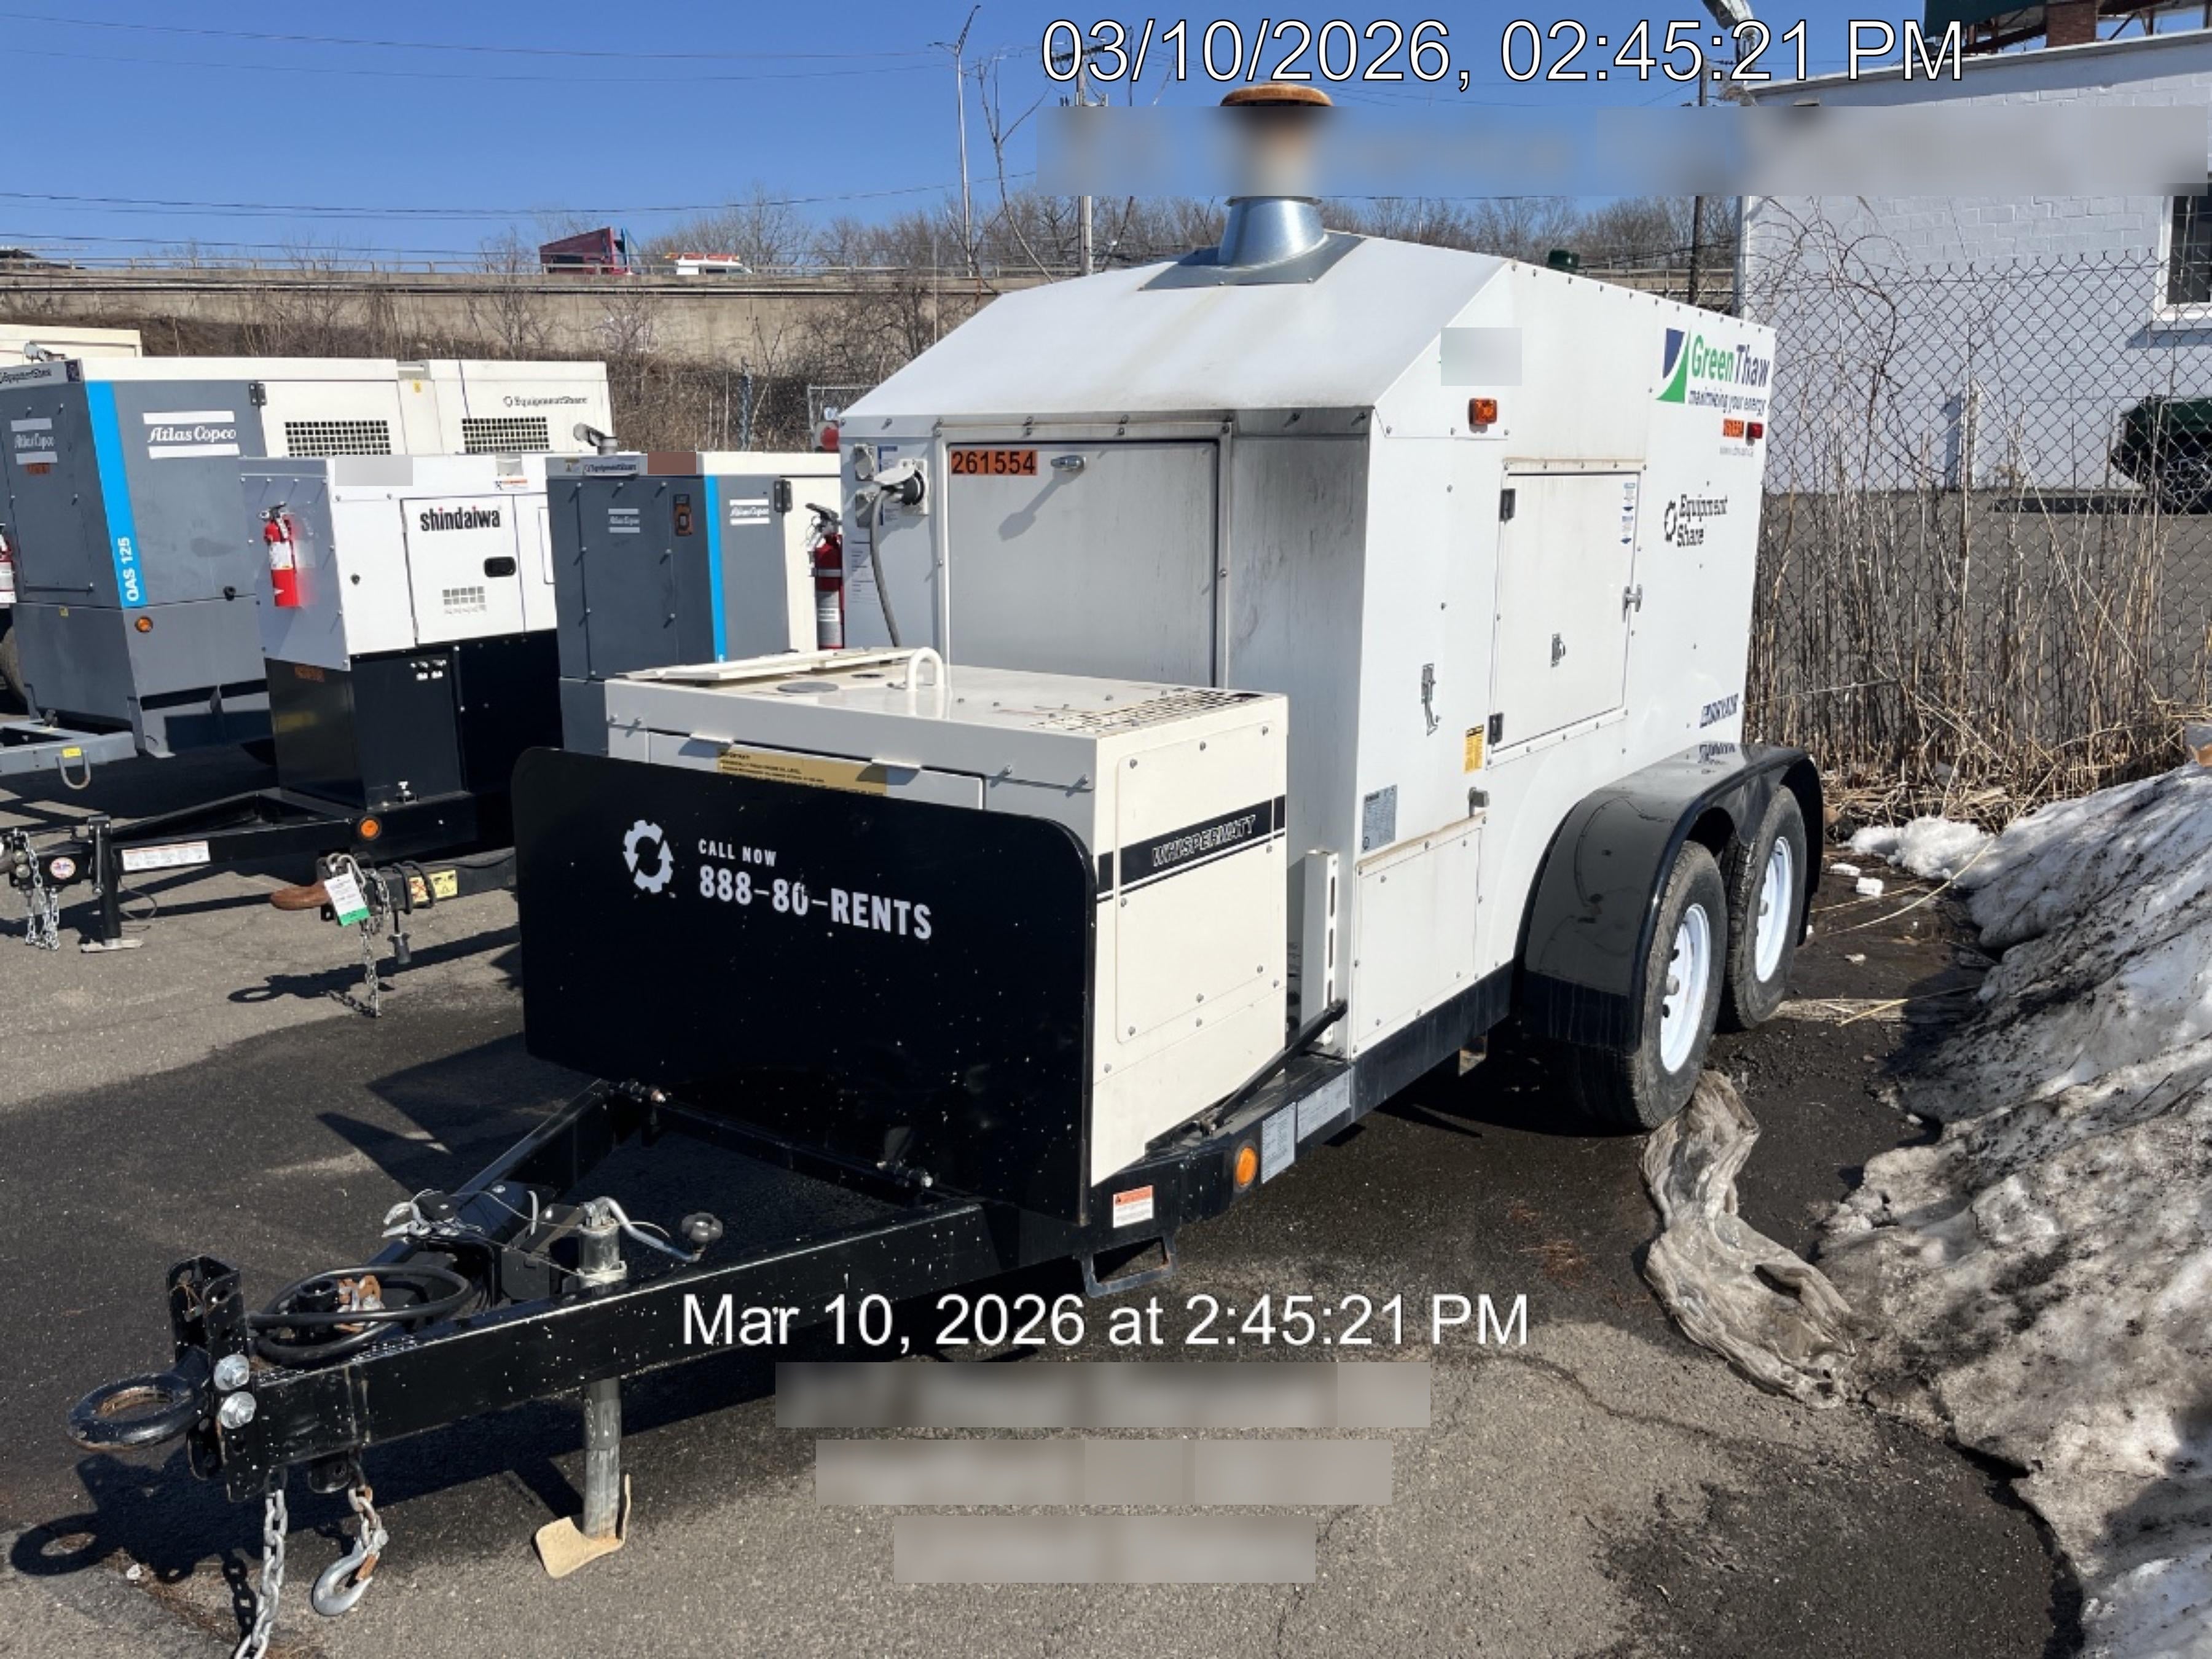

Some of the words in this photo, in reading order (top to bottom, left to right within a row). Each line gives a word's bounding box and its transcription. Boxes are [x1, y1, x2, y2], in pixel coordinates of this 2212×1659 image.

[147, 426, 192, 443] Atlas
[194, 425, 237, 442] Copco
[951, 450, 1036, 475] 261554
[420, 506, 500, 531] shindaiwa
[1679, 493, 1728, 522] Equipment
[1677, 524, 1704, 547] Share
[117, 536, 133, 565] 125
[698, 839, 735, 860] CALL
[742, 846, 777, 867] NOW
[1152, 814, 1256, 867] WHISPERWATT
[700, 865, 931, 939] 888-80-RENTS
